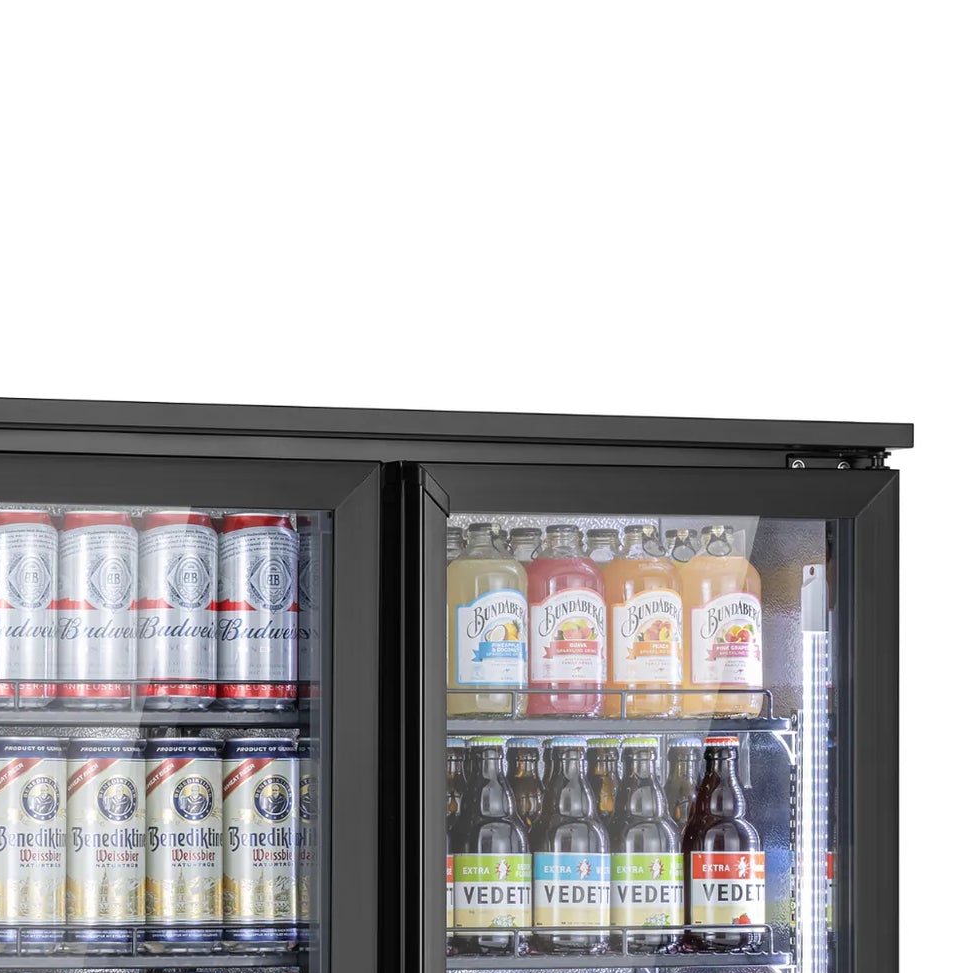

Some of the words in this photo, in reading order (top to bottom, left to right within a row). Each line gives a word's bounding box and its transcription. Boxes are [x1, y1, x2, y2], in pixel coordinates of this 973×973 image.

[20, 849, 61, 863] Weissbier
[95, 849, 138, 862] Weissbier
[171, 849, 215, 862] Weissbier
[462, 866, 490, 875] EXTRA
[544, 865, 572, 874] EXTRA
[617, 865, 644, 874] EXTRA
[702, 863, 730, 872] EXTRA
